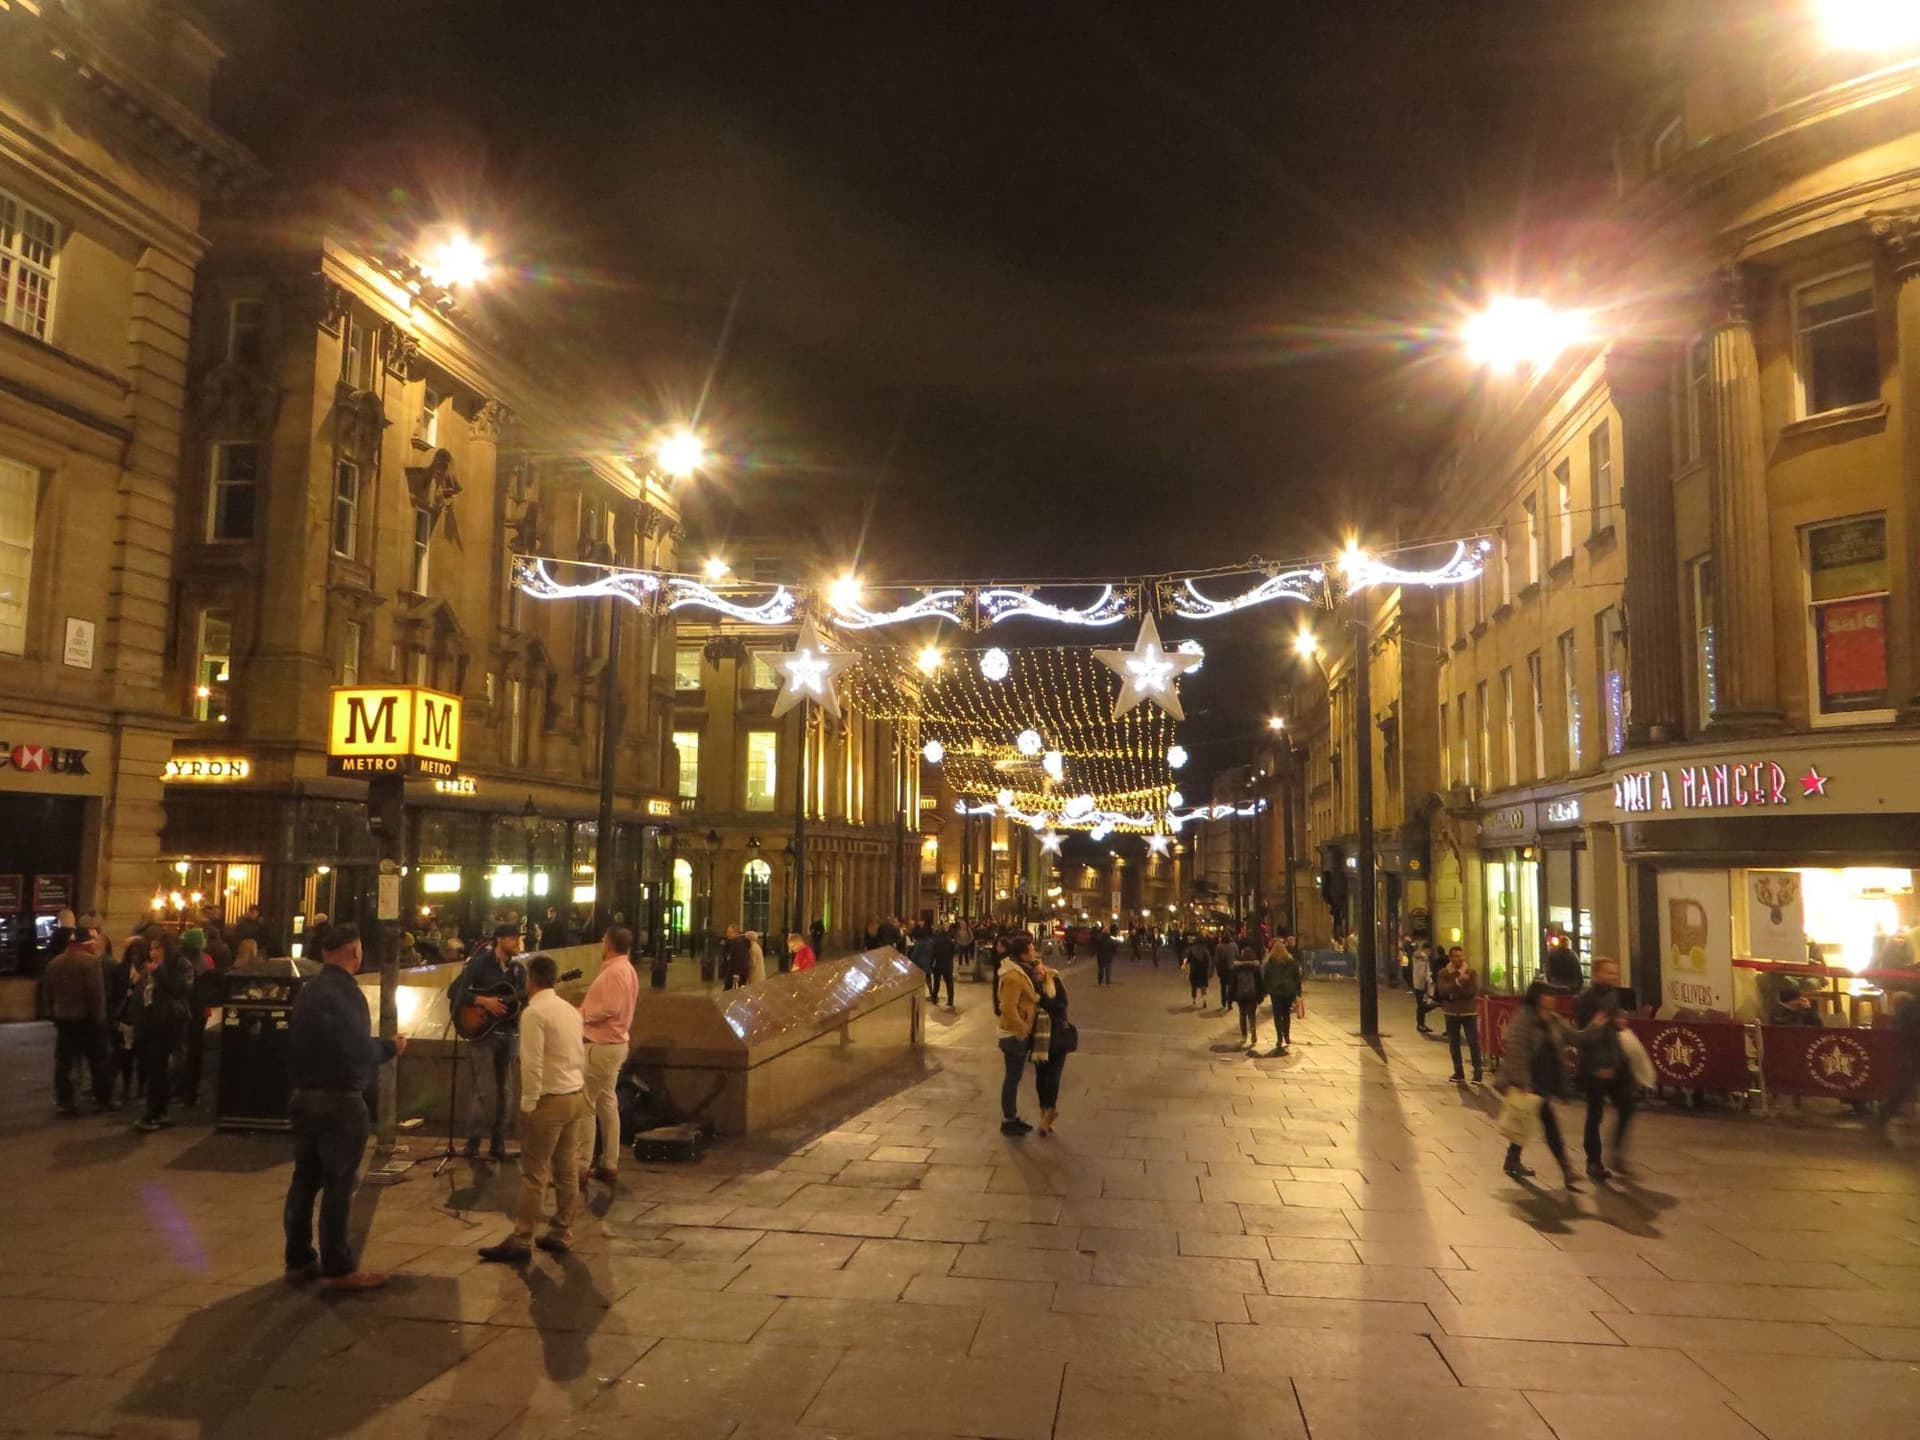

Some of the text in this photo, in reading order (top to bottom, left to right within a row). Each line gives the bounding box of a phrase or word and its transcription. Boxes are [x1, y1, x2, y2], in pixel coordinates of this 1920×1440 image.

[344, 696, 398, 744] M
[422, 699, 453, 750] M
[52, 747, 90, 777] UK
[173, 761, 243, 776] YRON
[342, 758, 397, 771] METRO
[420, 760, 452, 776] METRO
[1661, 770, 1673, 810] A
[1681, 761, 1787, 807] MANGER
[1682, 1028, 1706, 1052] COFFEE
